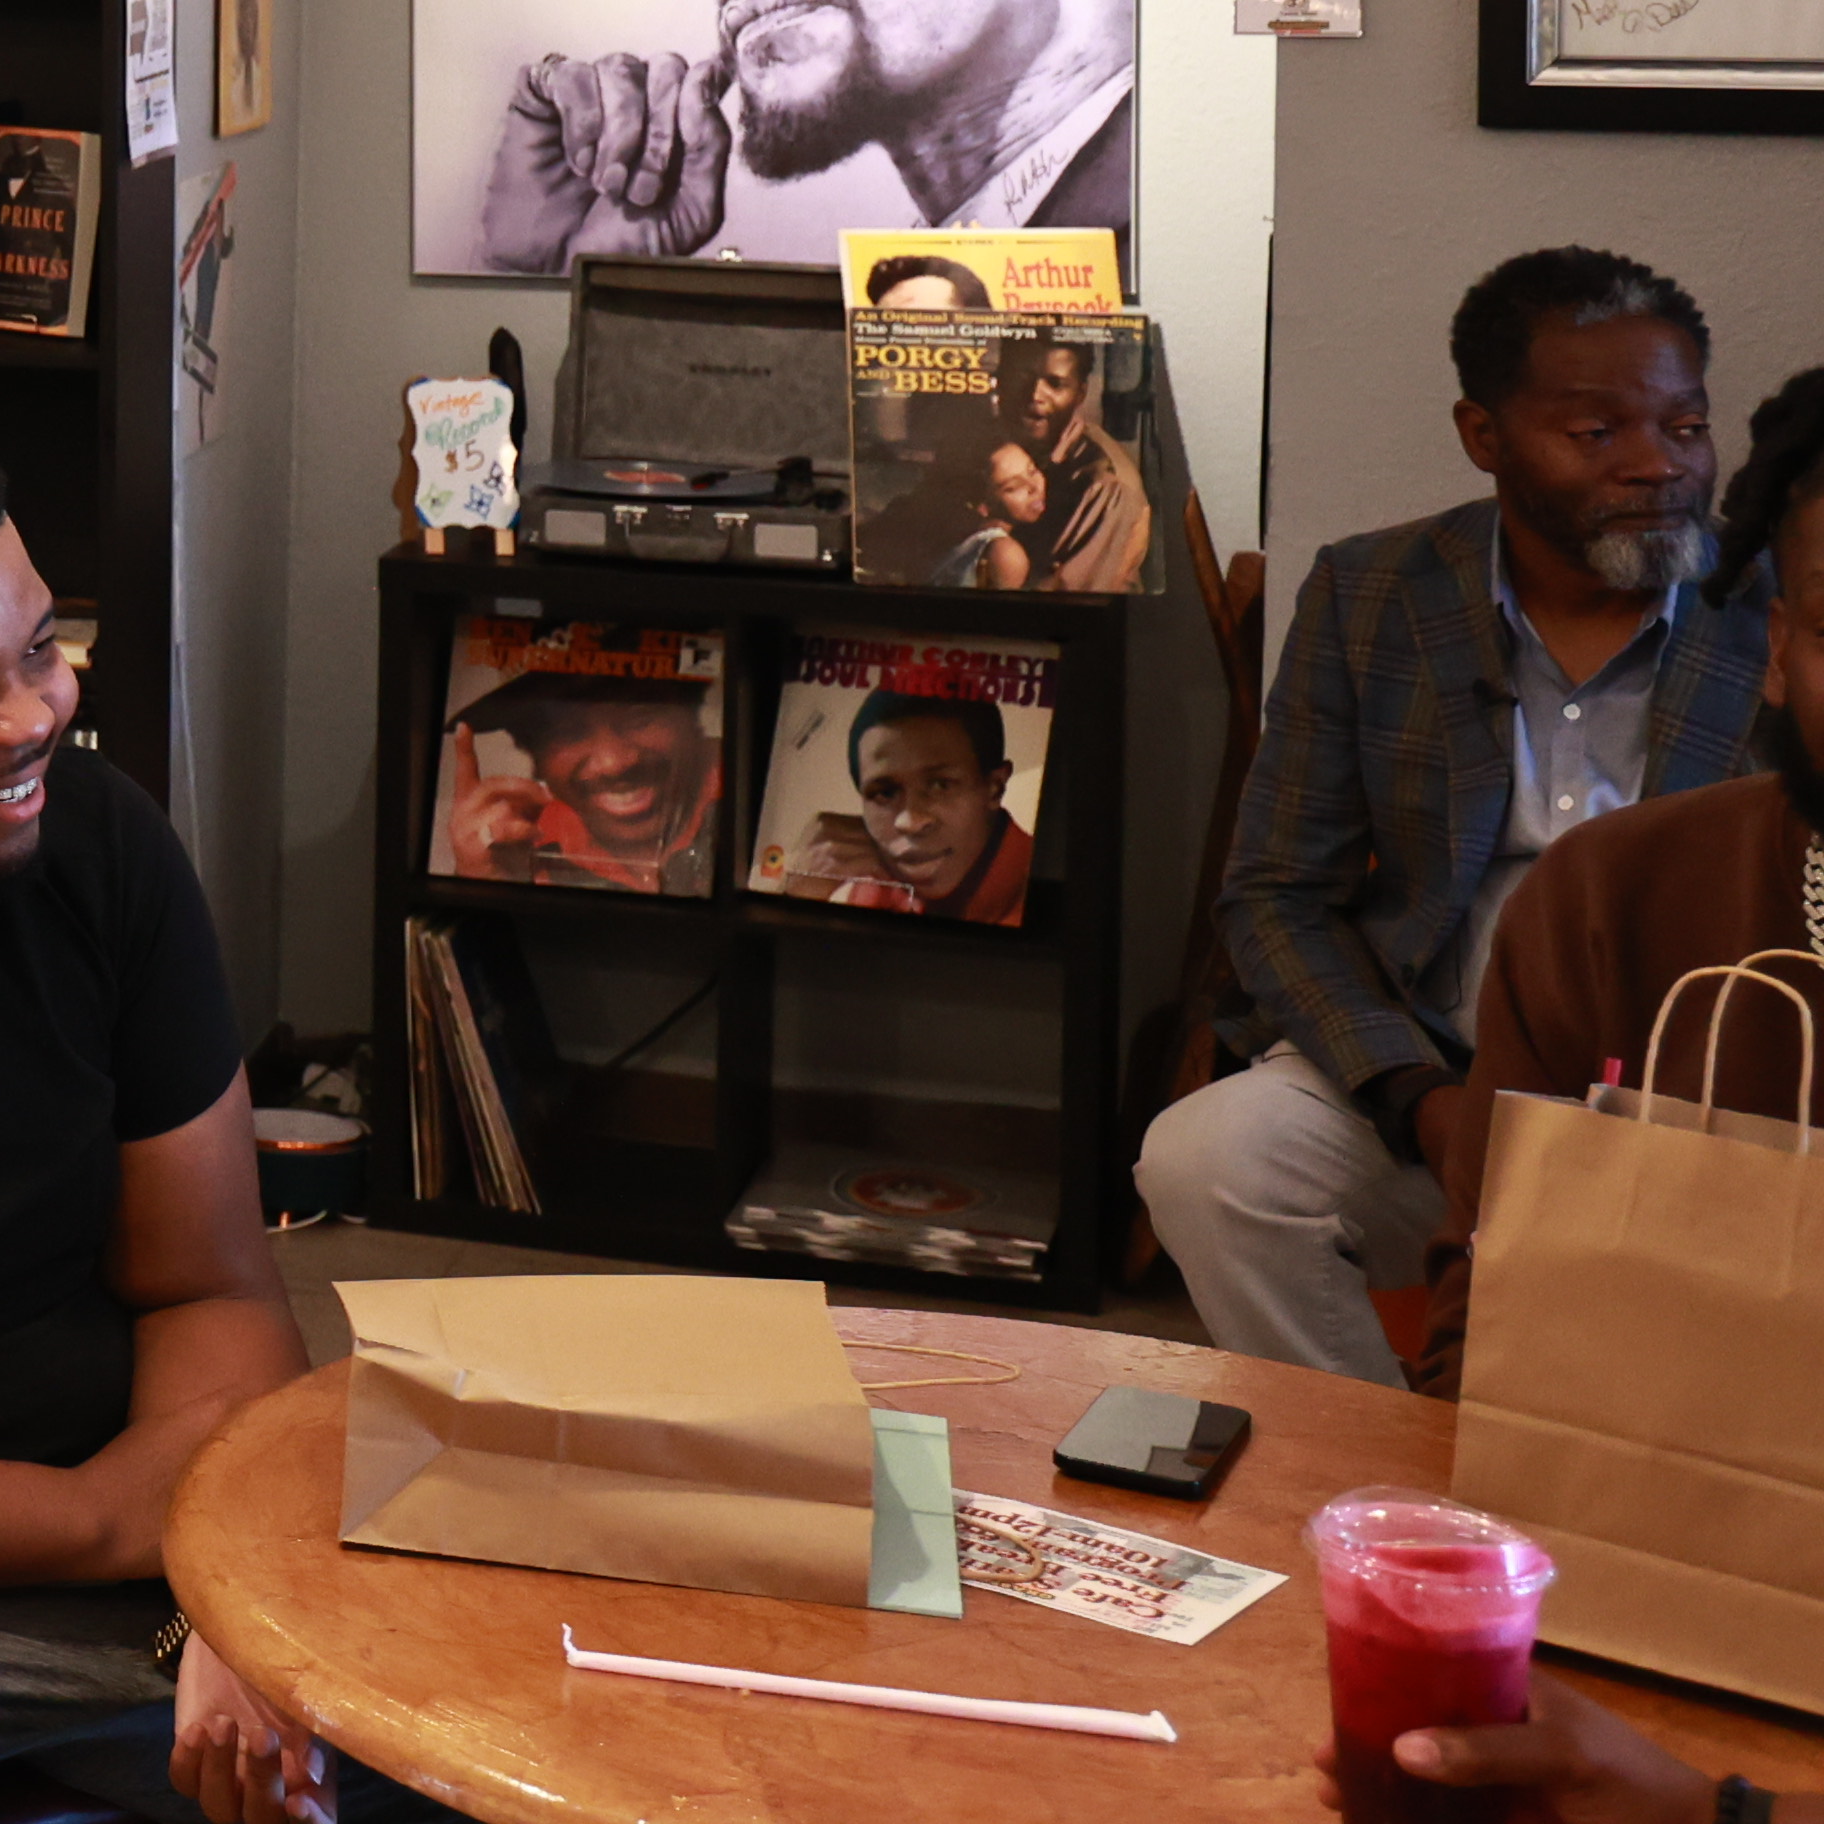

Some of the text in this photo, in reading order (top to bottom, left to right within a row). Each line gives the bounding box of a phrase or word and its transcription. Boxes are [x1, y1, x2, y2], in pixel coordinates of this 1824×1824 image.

[0, 204, 66, 233] PRINCE
[1003, 256, 1094, 289] Arthur
[855, 311, 877, 324] An
[884, 310, 949, 325] Original
[1062, 315, 1144, 331] Recording
[855, 323, 1037, 341] The Samuel Goldwyn
[855, 344, 989, 370] PORGY
[895, 371, 992, 395] BESS
[420, 391, 486, 418] Vintage
[958, 1505, 1168, 1569] 10am-12pm
[1079, 1572, 1171, 1605] Free
[1072, 1587, 1167, 1619] Cafe
